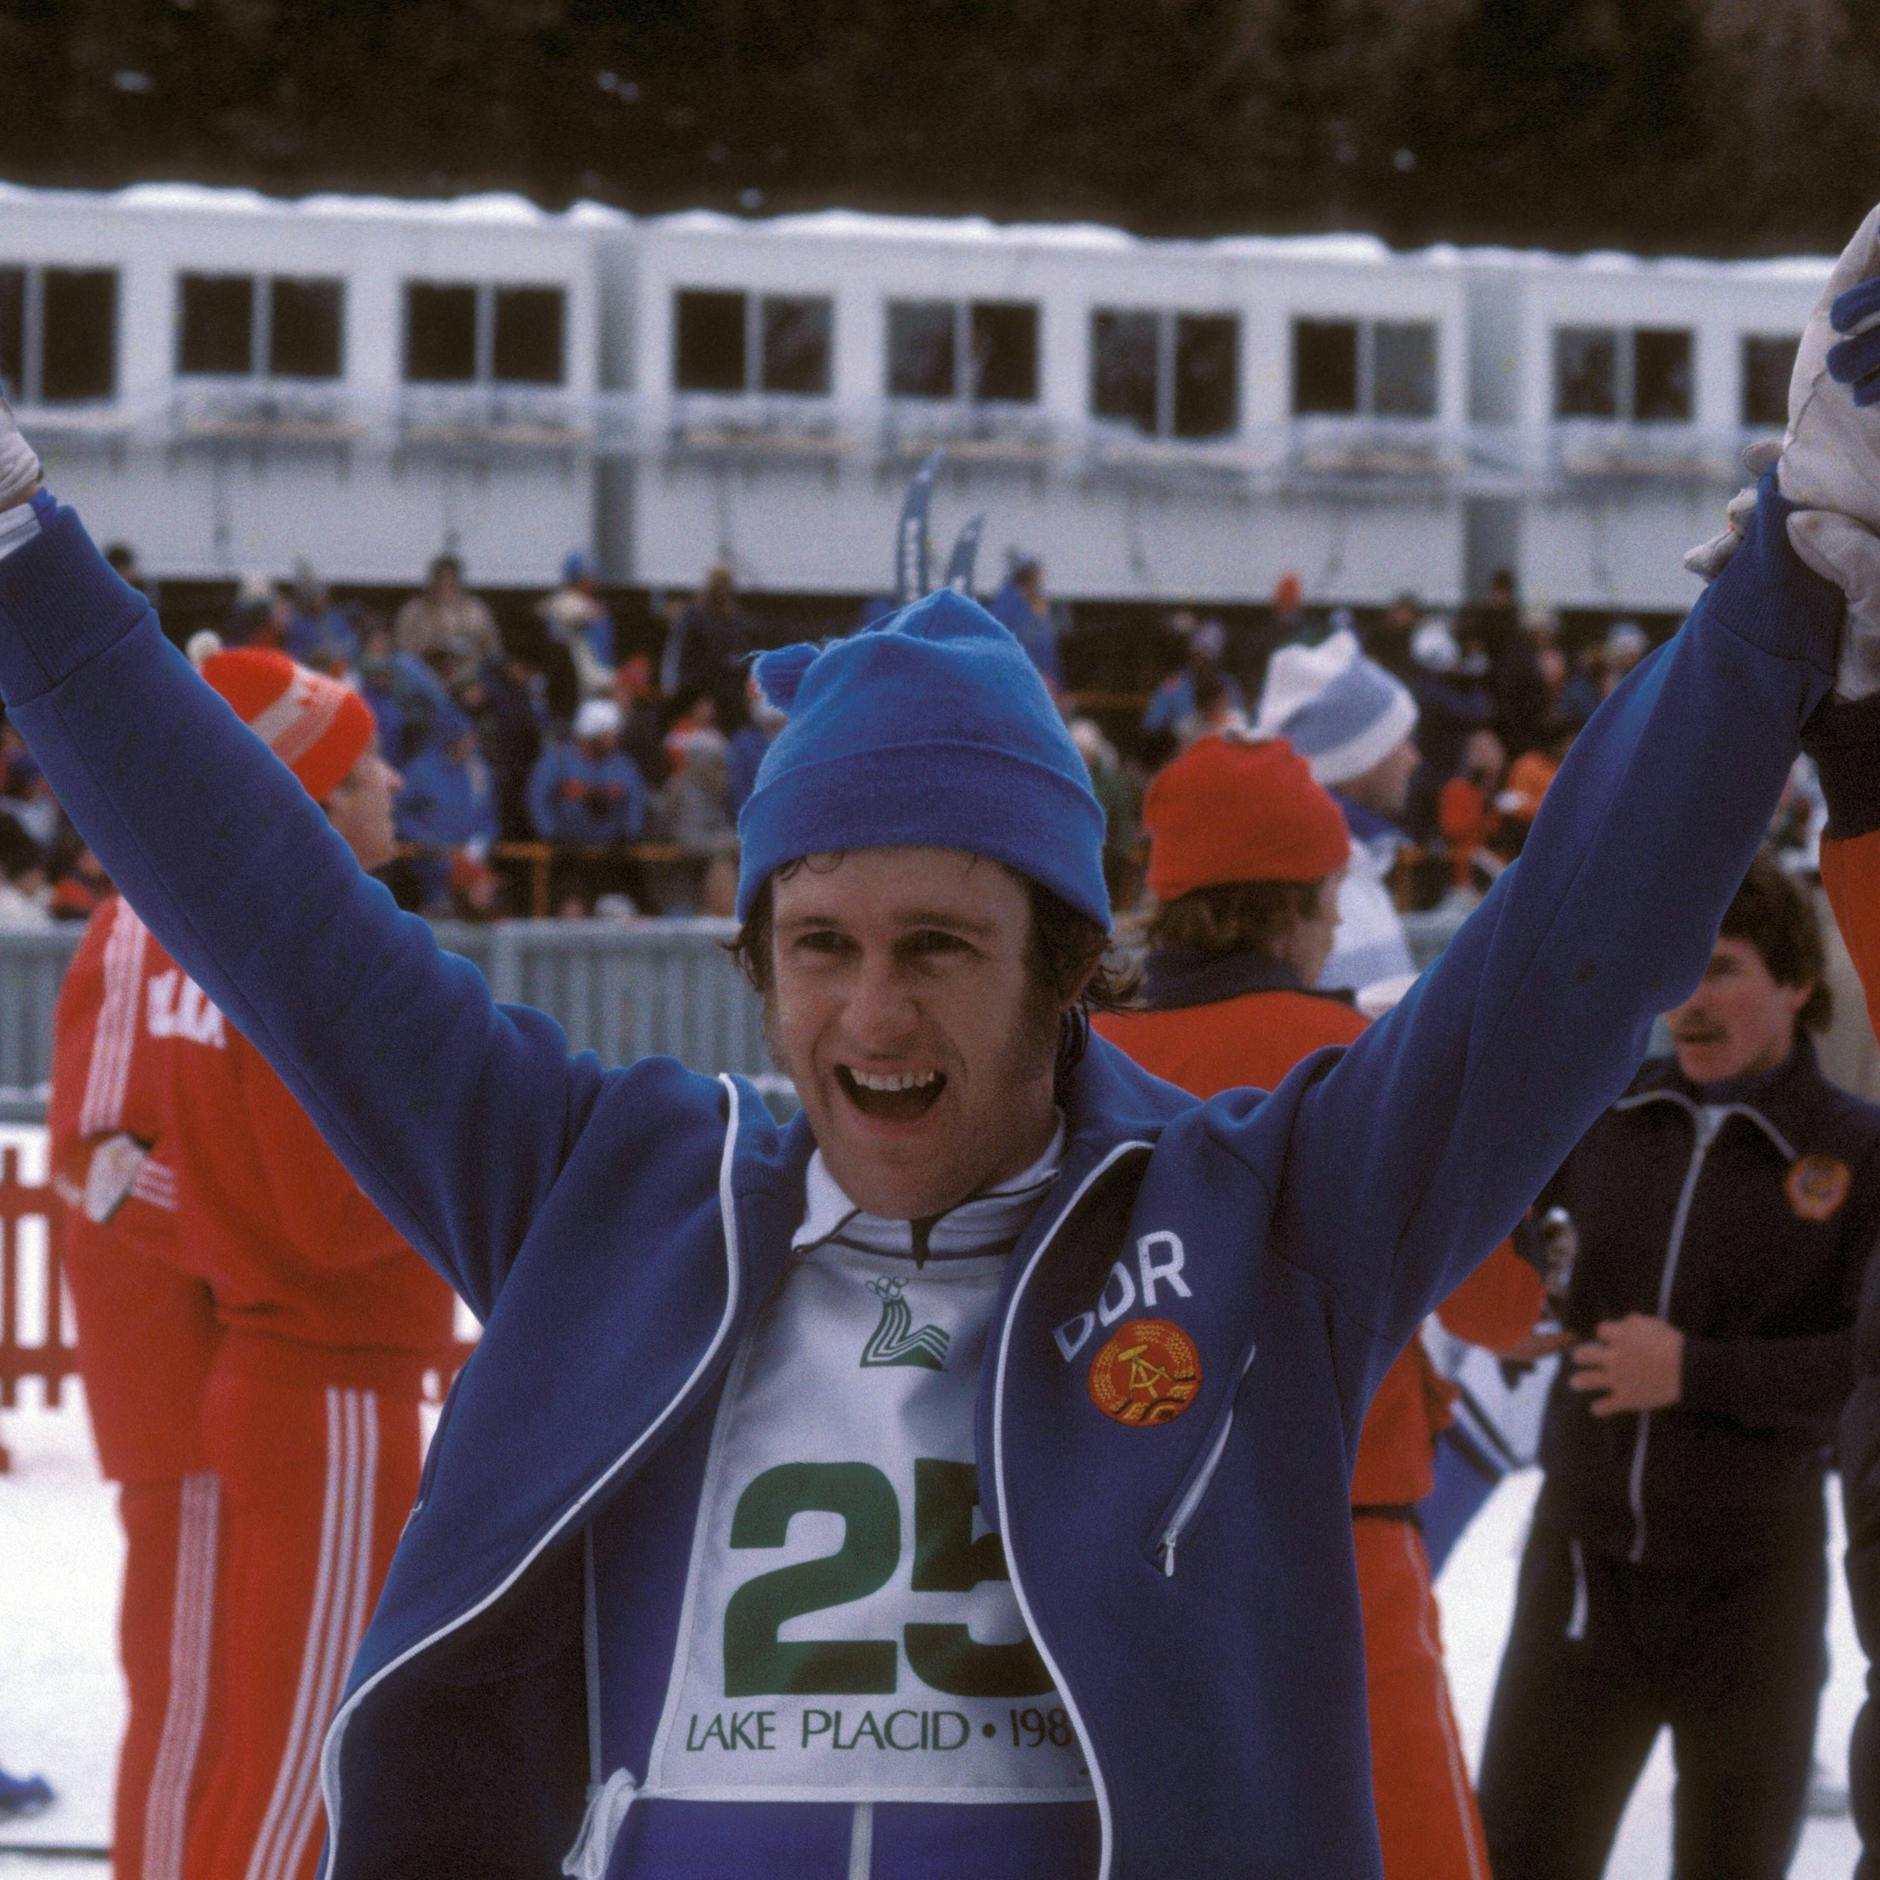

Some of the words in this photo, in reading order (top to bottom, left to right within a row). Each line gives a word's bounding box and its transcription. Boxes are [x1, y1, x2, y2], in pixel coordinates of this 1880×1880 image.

[1051, 1229, 1193, 1363] DDR
[724, 1458, 1057, 1697] 25
[686, 1711, 776, 1752] LAKE
[801, 1709, 971, 1752] PLACID
[1009, 1707, 1073, 1749] 198
